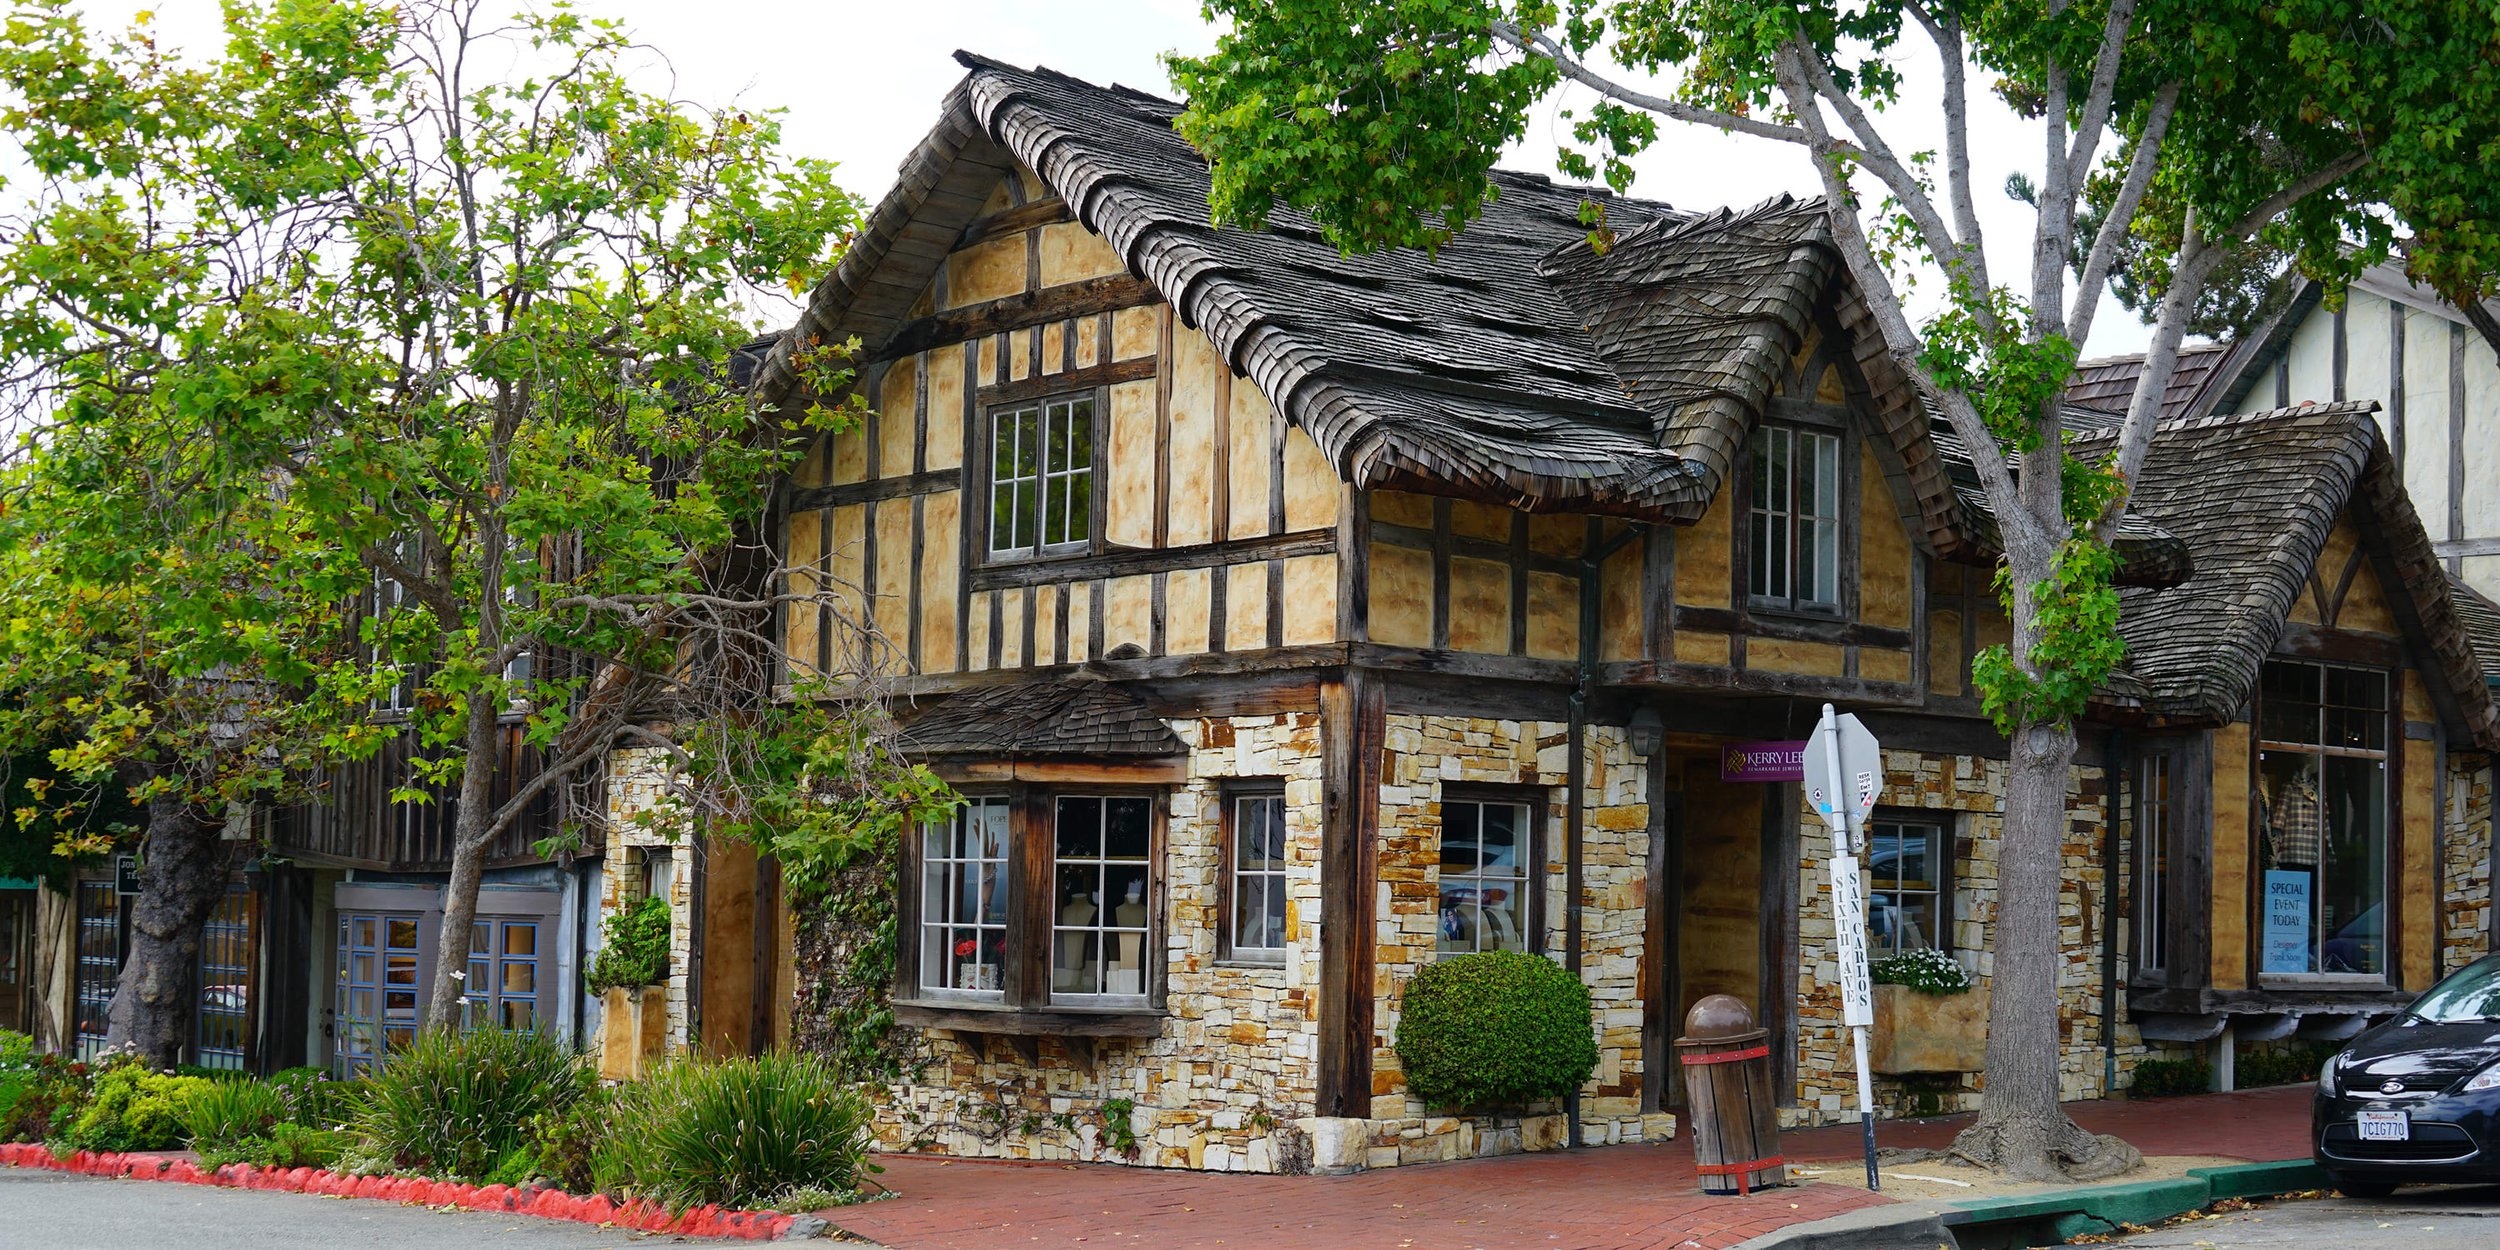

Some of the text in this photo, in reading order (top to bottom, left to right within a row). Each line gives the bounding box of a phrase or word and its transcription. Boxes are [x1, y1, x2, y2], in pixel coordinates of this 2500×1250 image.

[1747, 751, 1784, 766] KERRY
[2271, 882, 2304, 895] SPECIAL
[2274, 898, 2300, 910] EVENT
[2272, 914, 2301, 927] TODAY
[1835, 876, 1855, 1003] SIXTH AVE
[1849, 872, 1868, 1006] SAN CARLOS
[2362, 1122, 2404, 1135] 7CIG770
